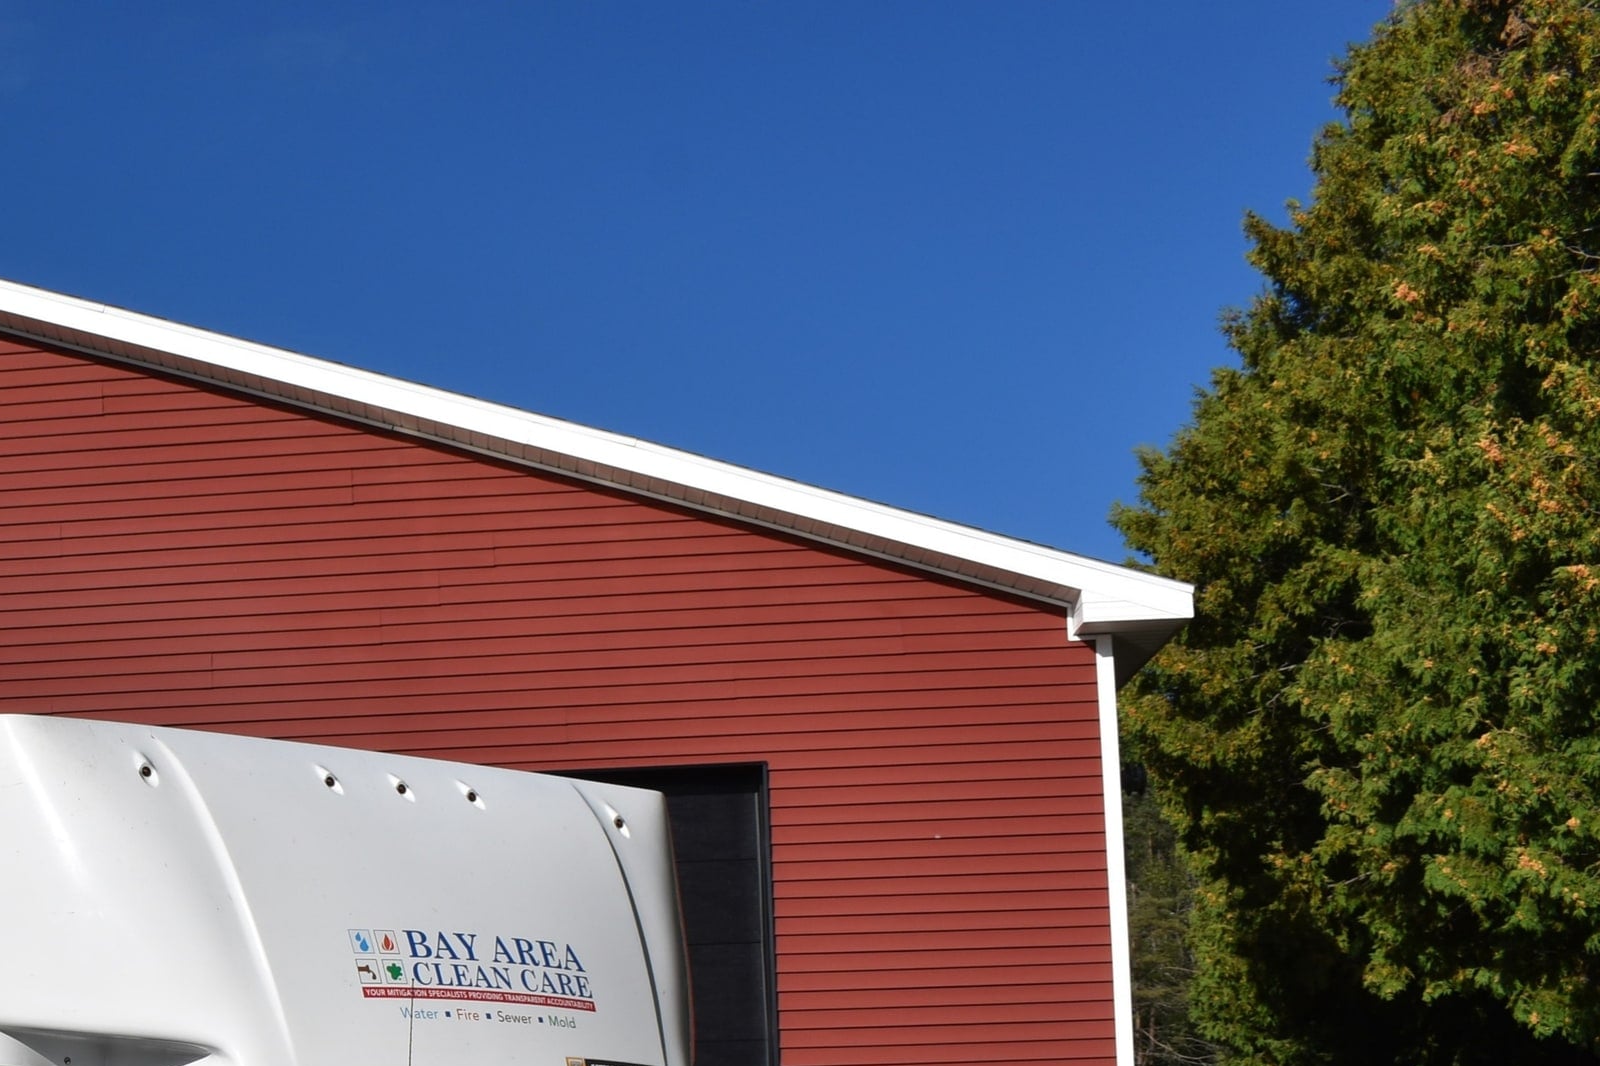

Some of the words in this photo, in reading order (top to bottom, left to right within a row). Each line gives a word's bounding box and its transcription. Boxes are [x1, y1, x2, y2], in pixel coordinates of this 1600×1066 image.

[402, 929, 477, 962] BAY
[492, 935, 586, 972] AREA
[412, 961, 512, 989] CLEAN
[523, 969, 593, 999] CARE
[365, 988, 386, 997] YOUR
[428, 990, 468, 999] SPECIALISTS
[468, 991, 503, 1001] PROVIDING
[504, 993, 546, 1004] TRANSPARENT
[547, 998, 594, 1010] ACCOUNTABILITY
[400, 1007, 438, 1020] Water
[456, 1008, 480, 1021] Fire
[497, 1010, 532, 1024] Sewer
[548, 1014, 577, 1028] Mold
